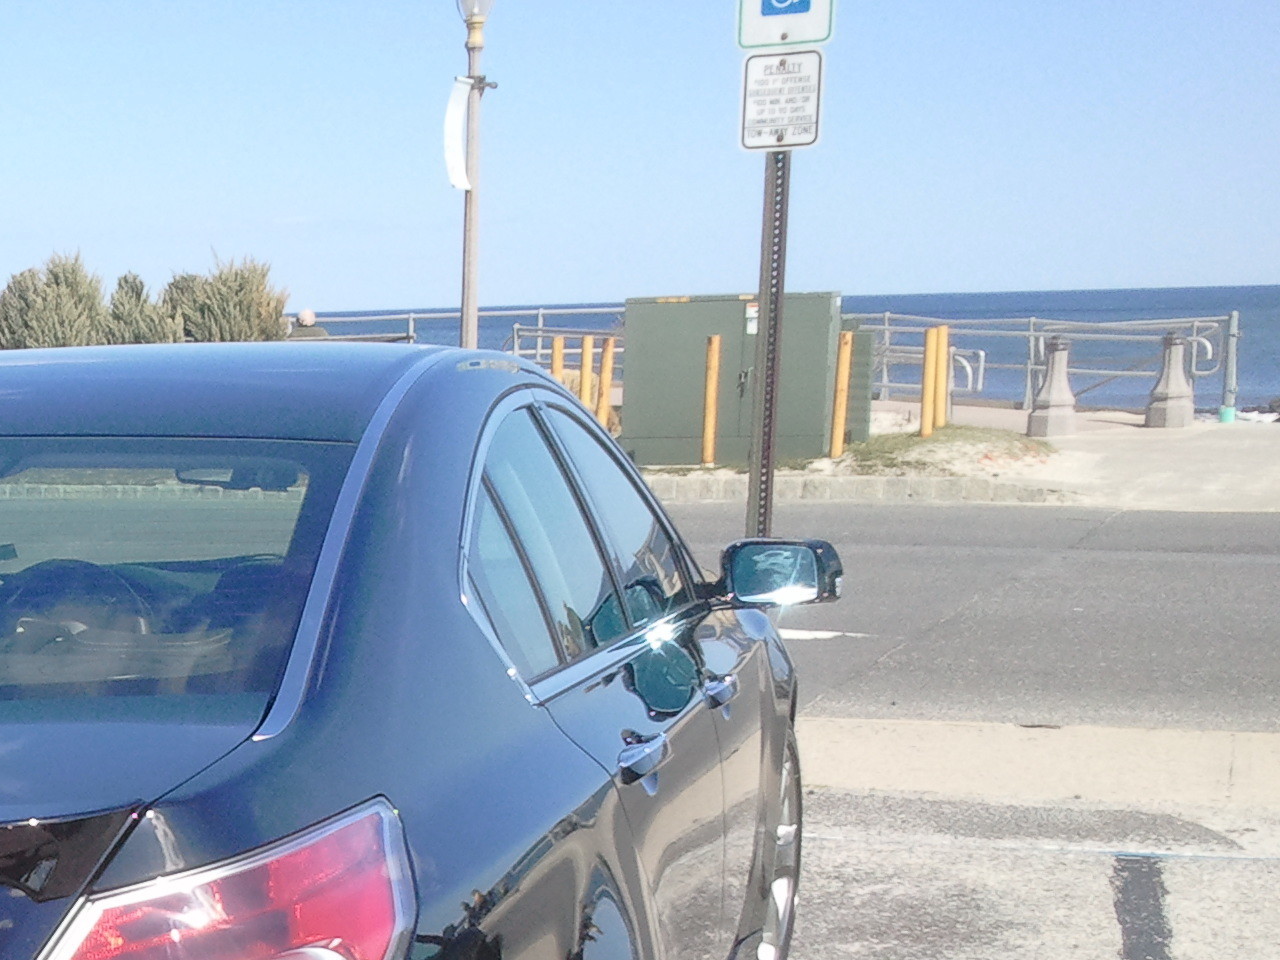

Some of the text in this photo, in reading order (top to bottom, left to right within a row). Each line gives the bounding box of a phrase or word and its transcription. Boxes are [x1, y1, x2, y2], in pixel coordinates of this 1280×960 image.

[764, 63, 803, 75] PENALTY
[747, 125, 813, 138] TOW-AWAY ZONE
